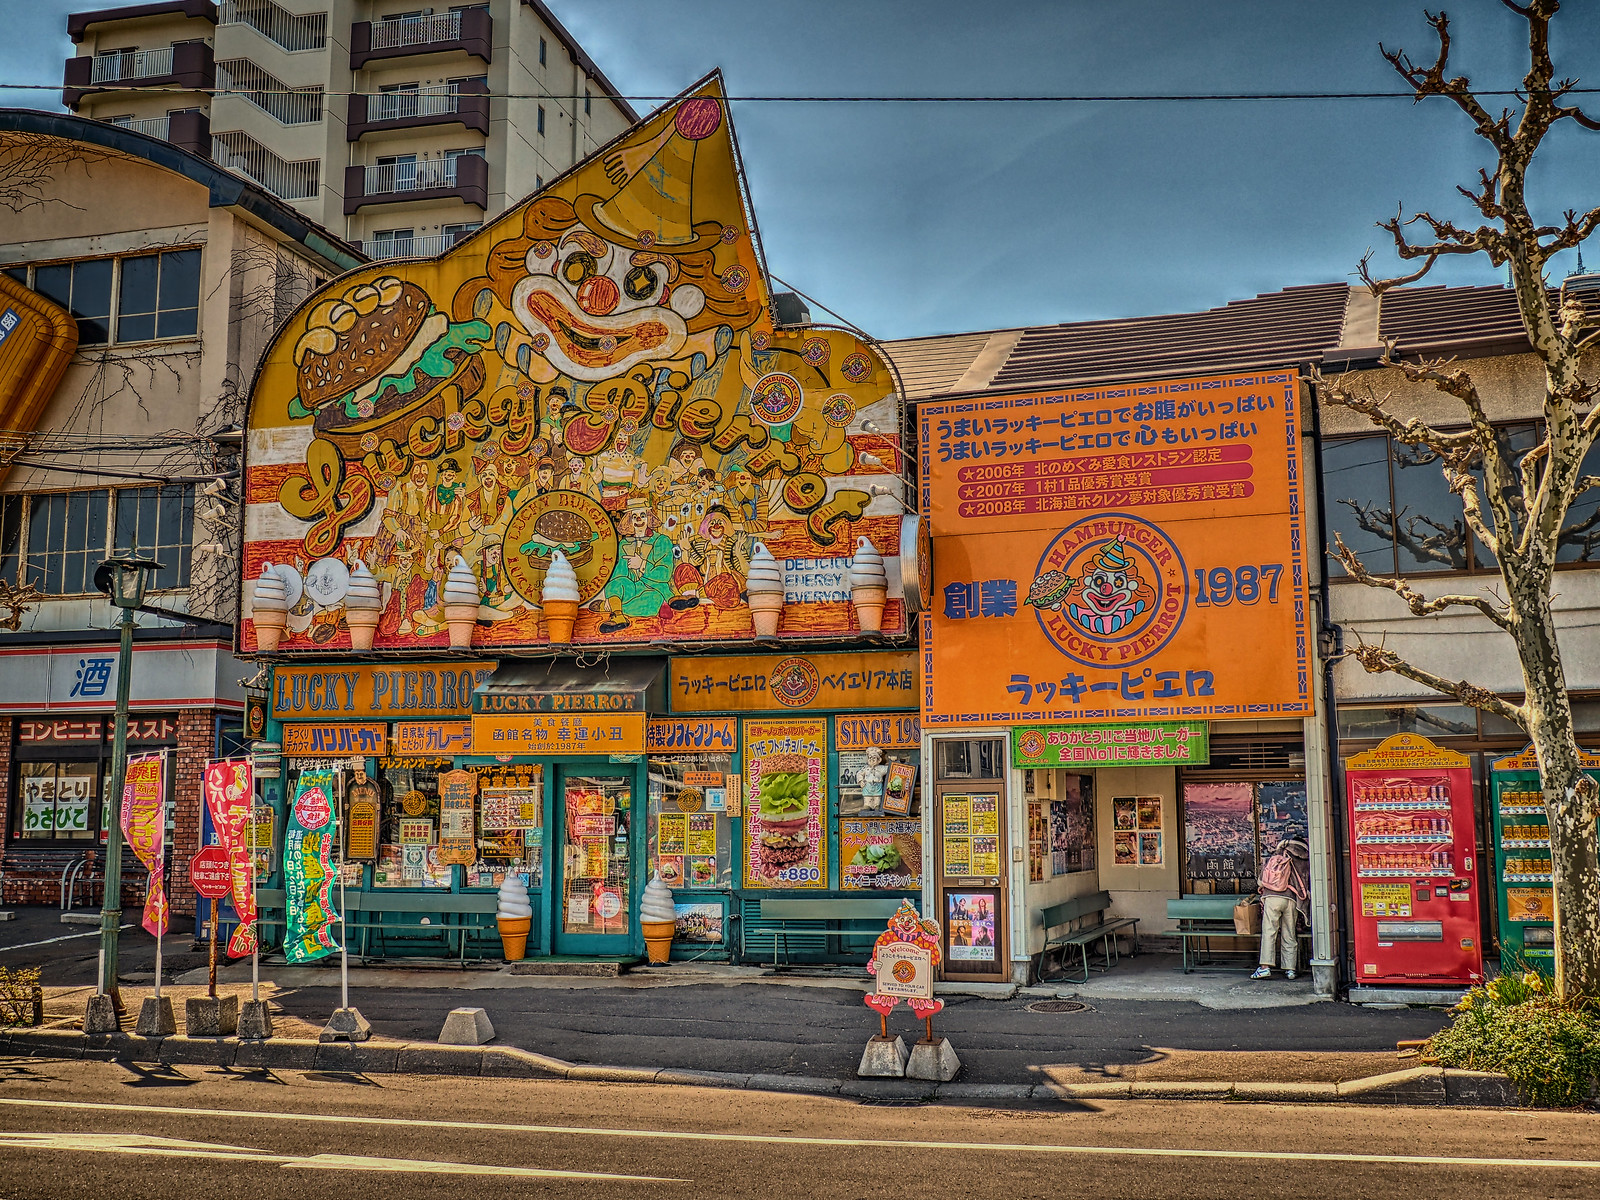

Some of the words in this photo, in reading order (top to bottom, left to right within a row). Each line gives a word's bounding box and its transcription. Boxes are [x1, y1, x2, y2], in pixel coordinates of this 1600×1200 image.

[758, 376, 796, 392] HAMBURGER
[756, 405, 778, 422] LUCKY
[779, 395, 799, 421] PIERROT
[936, 393, 1276, 440] うまいラッキーピエロでお腹がいっぱい
[279, 384, 541, 558] Lucky
[564, 364, 872, 547] Pierrot
[1034, 447, 1222, 476] 北のめぐみ愛食レストラン認定
[1036, 471, 1153, 494] 1村1品優秀賞受賞
[1035, 482, 1245, 512] 北海道ホクレン夢対象優秀賞受賞
[1049, 520, 1174, 567] HAMBURGER
[784, 572, 843, 588] ENERGY
[942, 579, 1019, 621] 創業
[1194, 564, 1285, 608] 1987
[1047, 614, 1110, 661] LUCKY
[1119, 581, 1183, 661] PIERROT
[776, 659, 815, 675] HAMBURGER
[69, 657, 115, 698] 酒
[678, 673, 767, 695] ラッキーピエロ
[821, 668, 913, 691] ベイエリア本店
[275, 671, 360, 712] LUCKY
[775, 688, 797, 705] LUCKY
[797, 678, 818, 705] PIERROT
[1006, 669, 1215, 706] ラッキーピエロ
[480, 694, 545, 712] LUCKY
[551, 693, 637, 711] PIERROT
[287, 728, 309, 740] 手づくり
[310, 727, 383, 752] ハンバーガー
[402, 726, 426, 739] 自家製
[492, 728, 549, 742] 函館名物
[557, 726, 624, 742] 幸運小丑
[646, 724, 666, 747] 特製
[667, 722, 733, 748] ソフトクリーム
[840, 719, 892, 746] SINCE
[1047, 726, 1202, 745] ありがとう!!ご当地バーガー
[286, 740, 310, 752] デカウマ
[401, 739, 425, 751] こだわり
[749, 739, 766, 758] THE
[1058, 744, 1190, 762] 全国No1に輝きました
[1373, 750, 1440, 759] 大好きミルクコーヒー
[379, 757, 451, 770] テレフォンオーダー
[1507, 760, 1519, 769] 祝
[26, 781, 88, 803] やきとり
[351, 786, 376, 797] MENU
[199, 860, 230, 869] 店頭につき
[779, 867, 820, 881] ¥880
[1190, 870, 1252, 878] HAKODATE
[1206, 858, 1235, 871] 函館
[889, 946, 920, 956] Welcome
